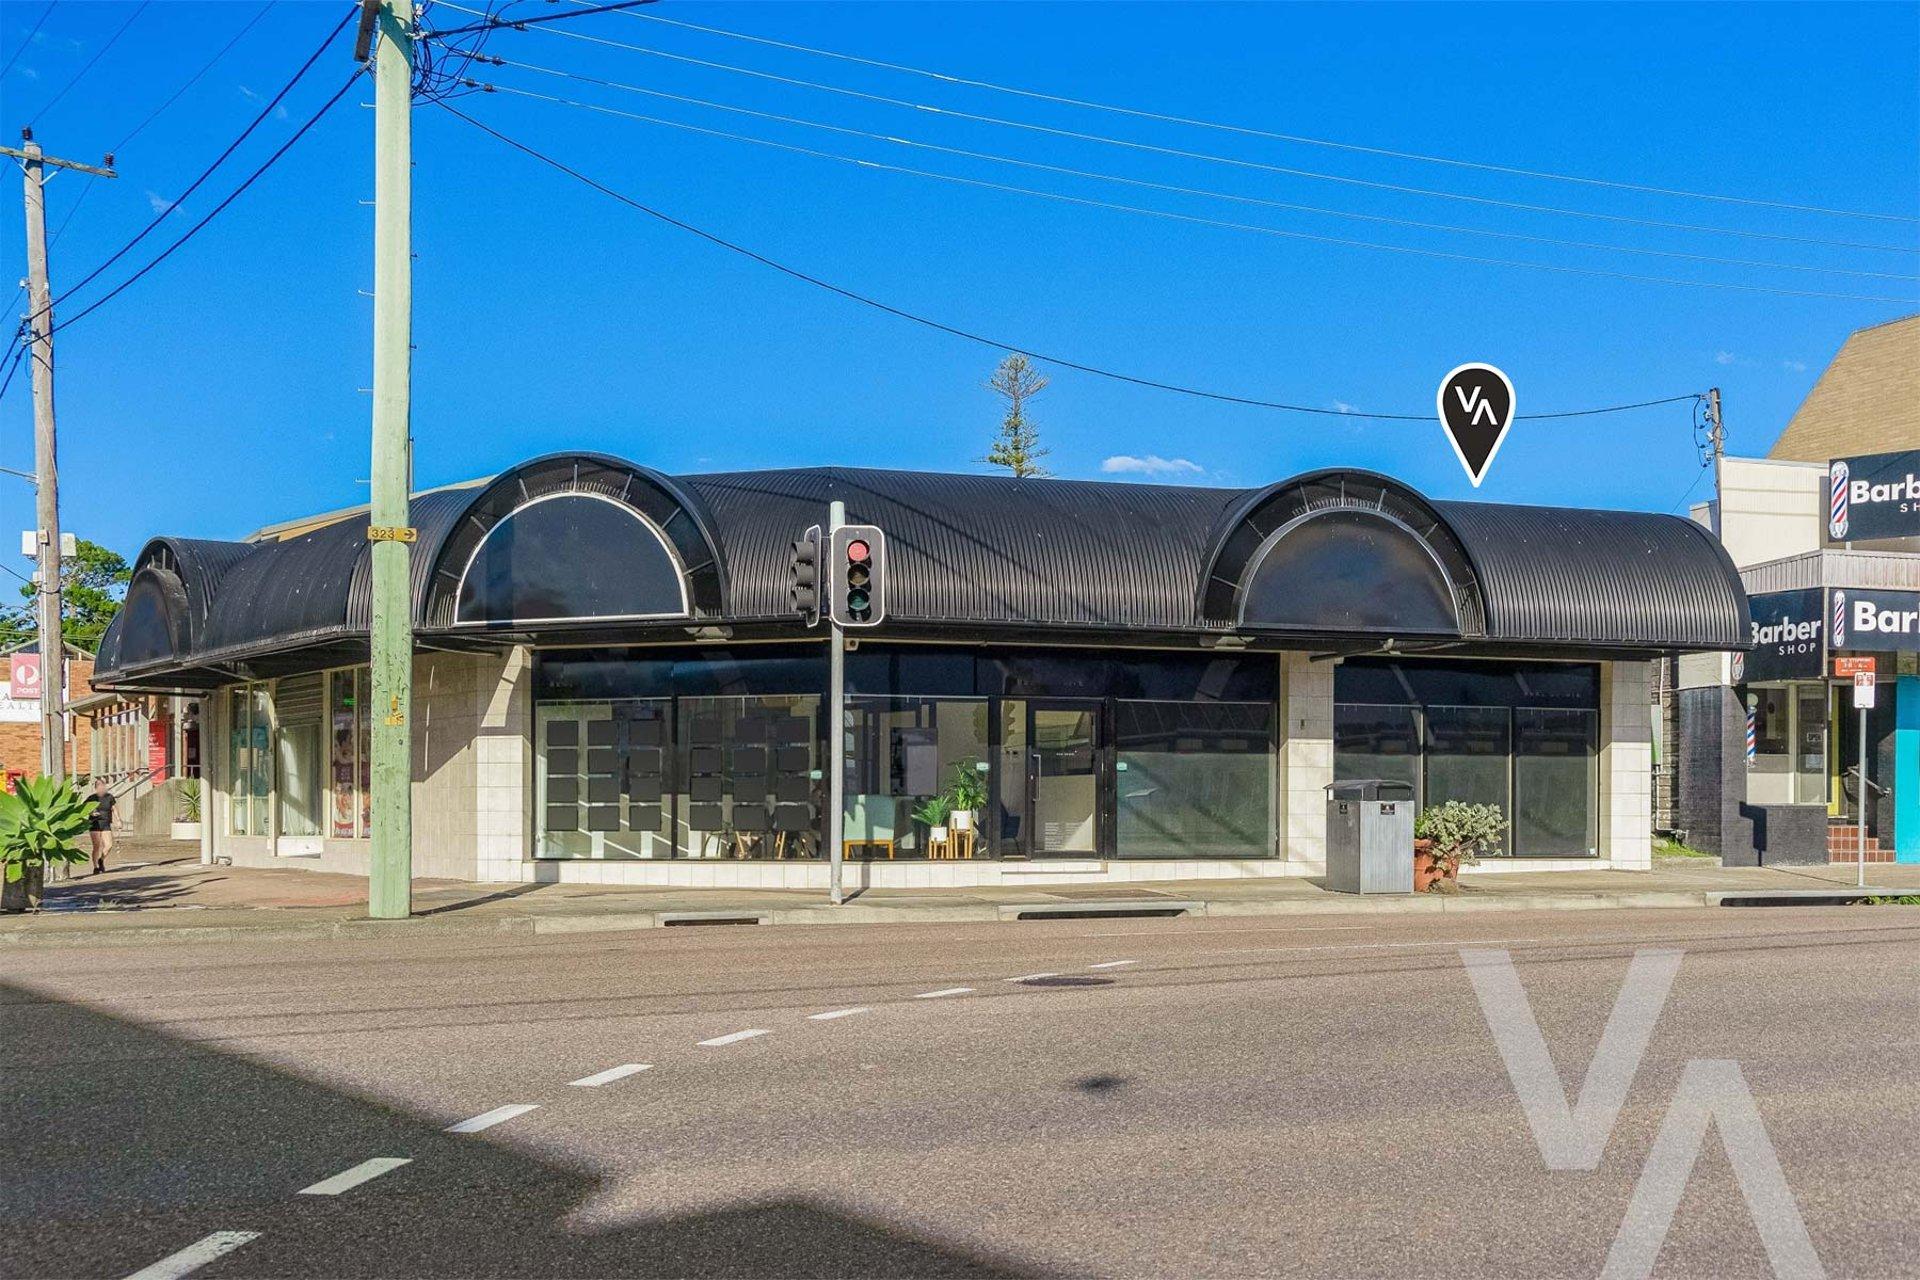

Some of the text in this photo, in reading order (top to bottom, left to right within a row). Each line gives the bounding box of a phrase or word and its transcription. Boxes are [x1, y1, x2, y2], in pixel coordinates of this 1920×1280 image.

[371, 529, 395, 539] 323
[1853, 600, 1920, 633] Bar
[1778, 642, 1817, 656] SHOP
[16, 687, 39, 696] POST
